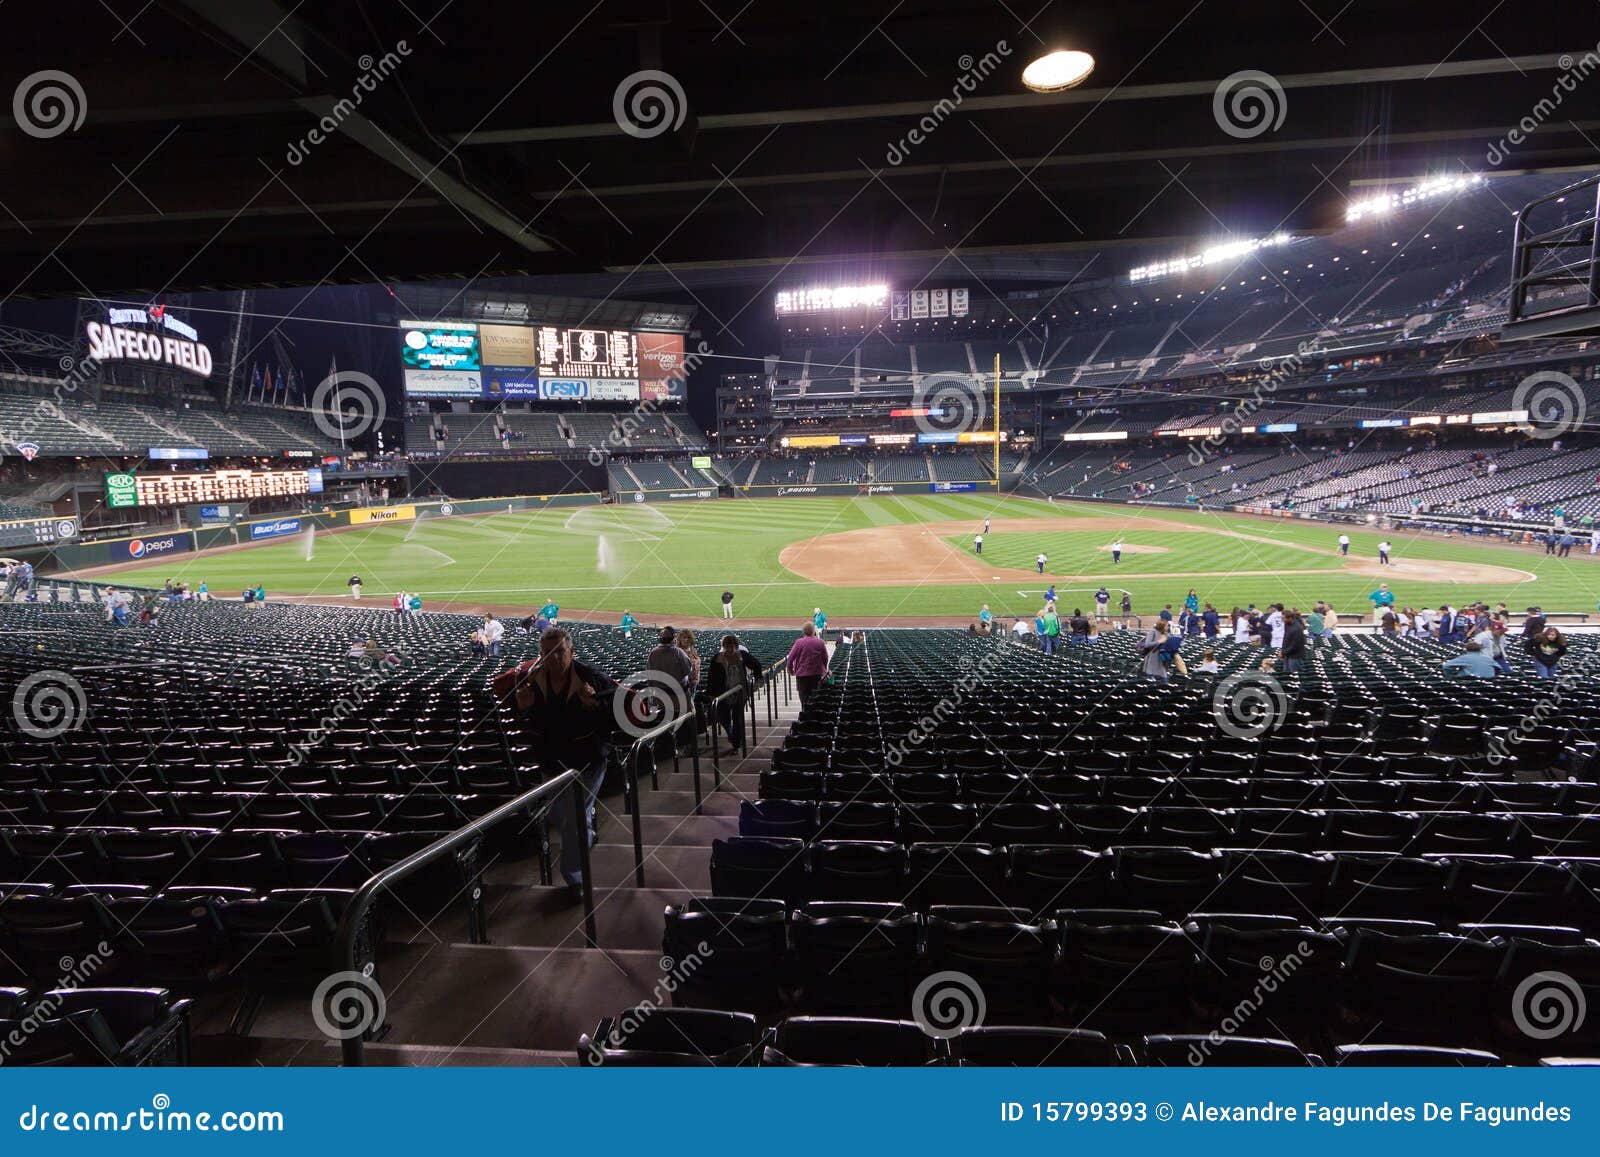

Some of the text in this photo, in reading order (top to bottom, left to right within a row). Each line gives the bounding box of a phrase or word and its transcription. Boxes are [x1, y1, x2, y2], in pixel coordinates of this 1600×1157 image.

[87, 321, 212, 378] SAFECO FIELD
[643, 352, 676, 361] verizon
[550, 382, 580, 396] FSN
[370, 510, 398, 520] Nikon
[254, 521, 299, 535] BUD LIGHT
[145, 537, 174, 554] pepsi
